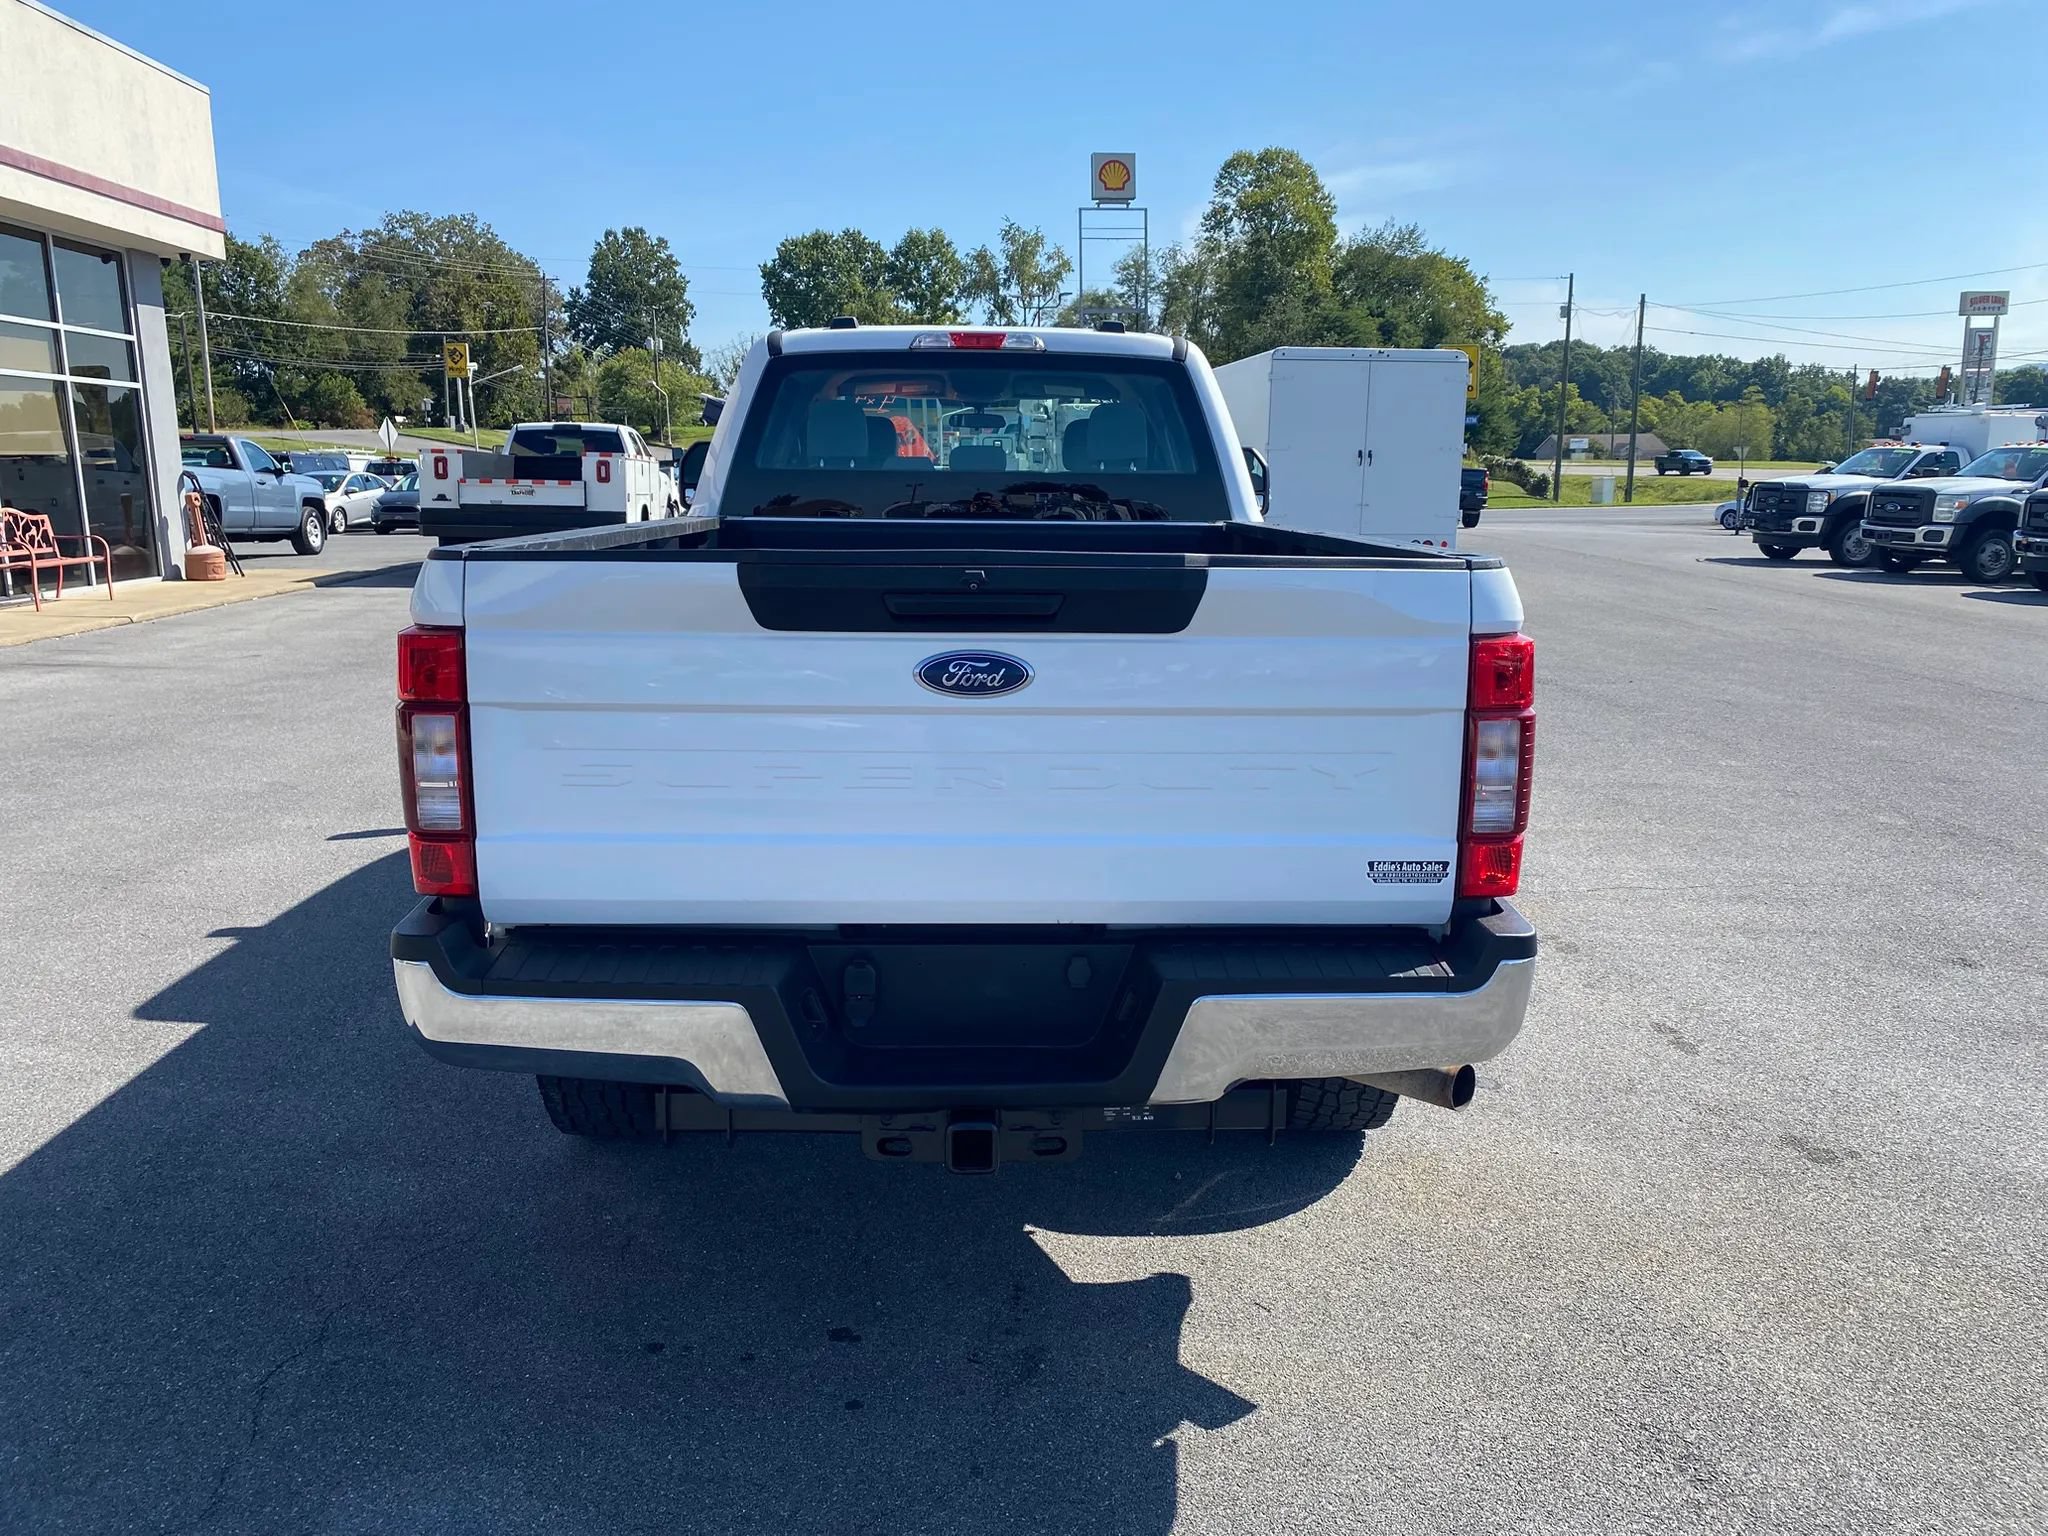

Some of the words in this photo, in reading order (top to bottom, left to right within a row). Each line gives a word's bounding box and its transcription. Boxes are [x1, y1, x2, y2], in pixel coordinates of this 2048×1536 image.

[942, 660, 1006, 687] Ford
[1373, 861, 1401, 871] Eddie's
[1402, 861, 1421, 871] Auto
[1422, 861, 1443, 871] Sales
